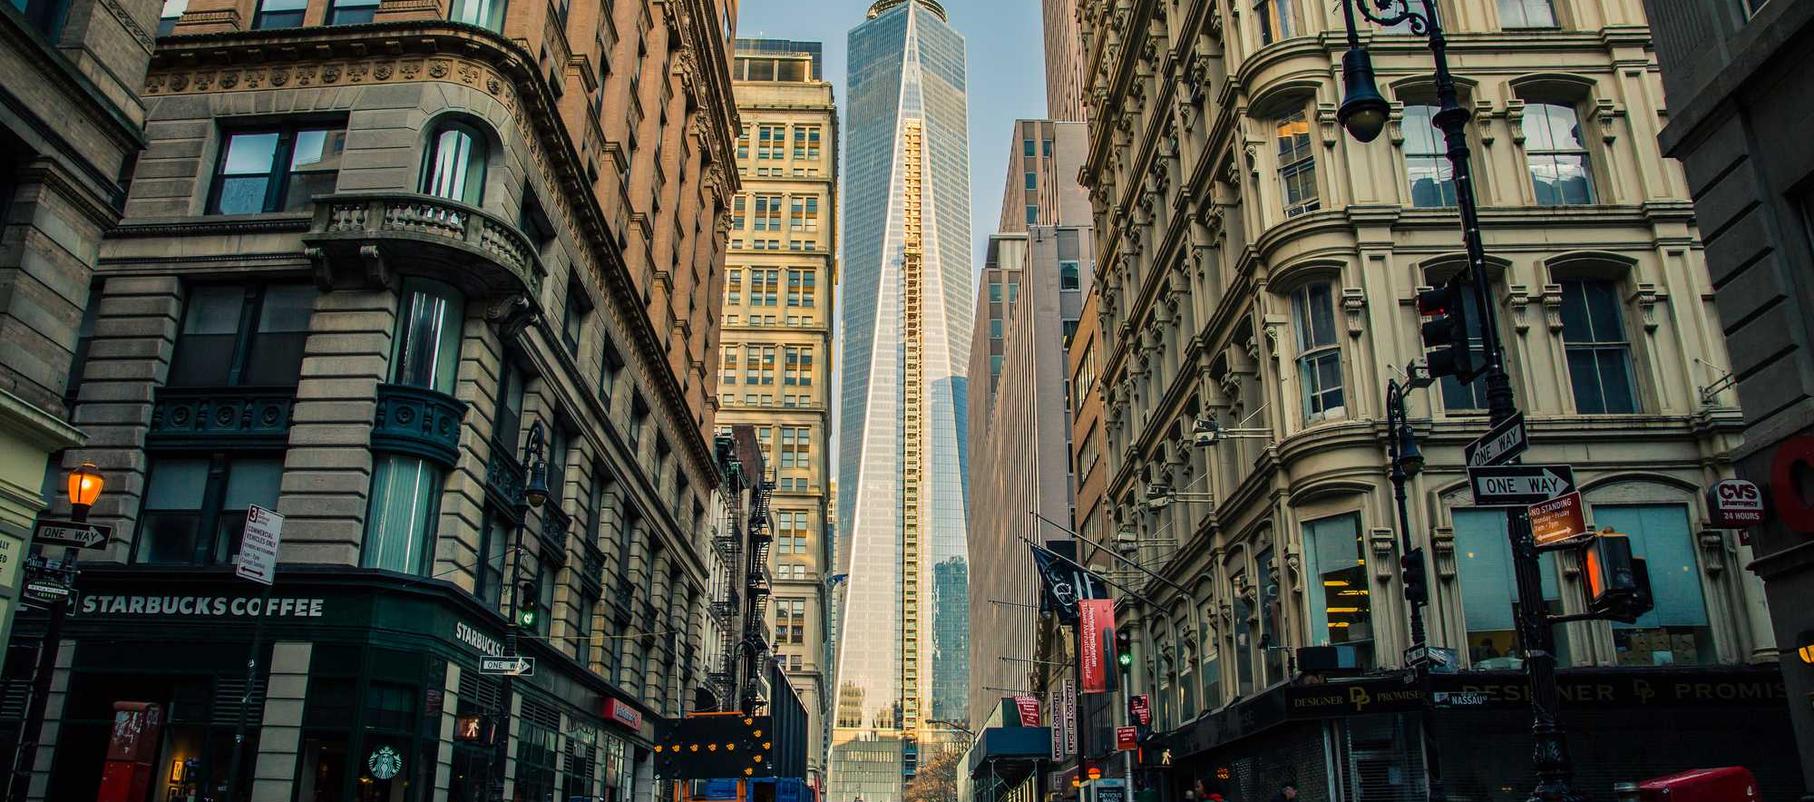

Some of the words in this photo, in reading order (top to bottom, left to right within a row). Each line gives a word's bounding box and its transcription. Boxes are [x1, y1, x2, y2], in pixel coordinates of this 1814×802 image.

[1474, 446, 1492, 466] ONE
[1498, 428, 1518, 452] WAY
[1486, 478, 1516, 494] ONE
[1528, 478, 1558, 493] WAY
[1718, 484, 1758, 500] CVS
[249, 507, 258, 522] 3
[1530, 508, 1540, 516] NO
[1540, 498, 1572, 514] STANDING
[1734, 512, 1760, 520] HOURS
[44, 527, 66, 538] ONE
[74, 530, 98, 542] WAY
[83, 596, 228, 615] STARBUCKS
[231, 598, 325, 616] COFFEE
[456, 622, 501, 658] STARBUCKS
[1066, 680, 1074, 718] Roberts
[1294, 694, 1344, 708] DESIGNER
[1376, 690, 1420, 703] PROMISE
[1451, 694, 1482, 705] NASSAU
